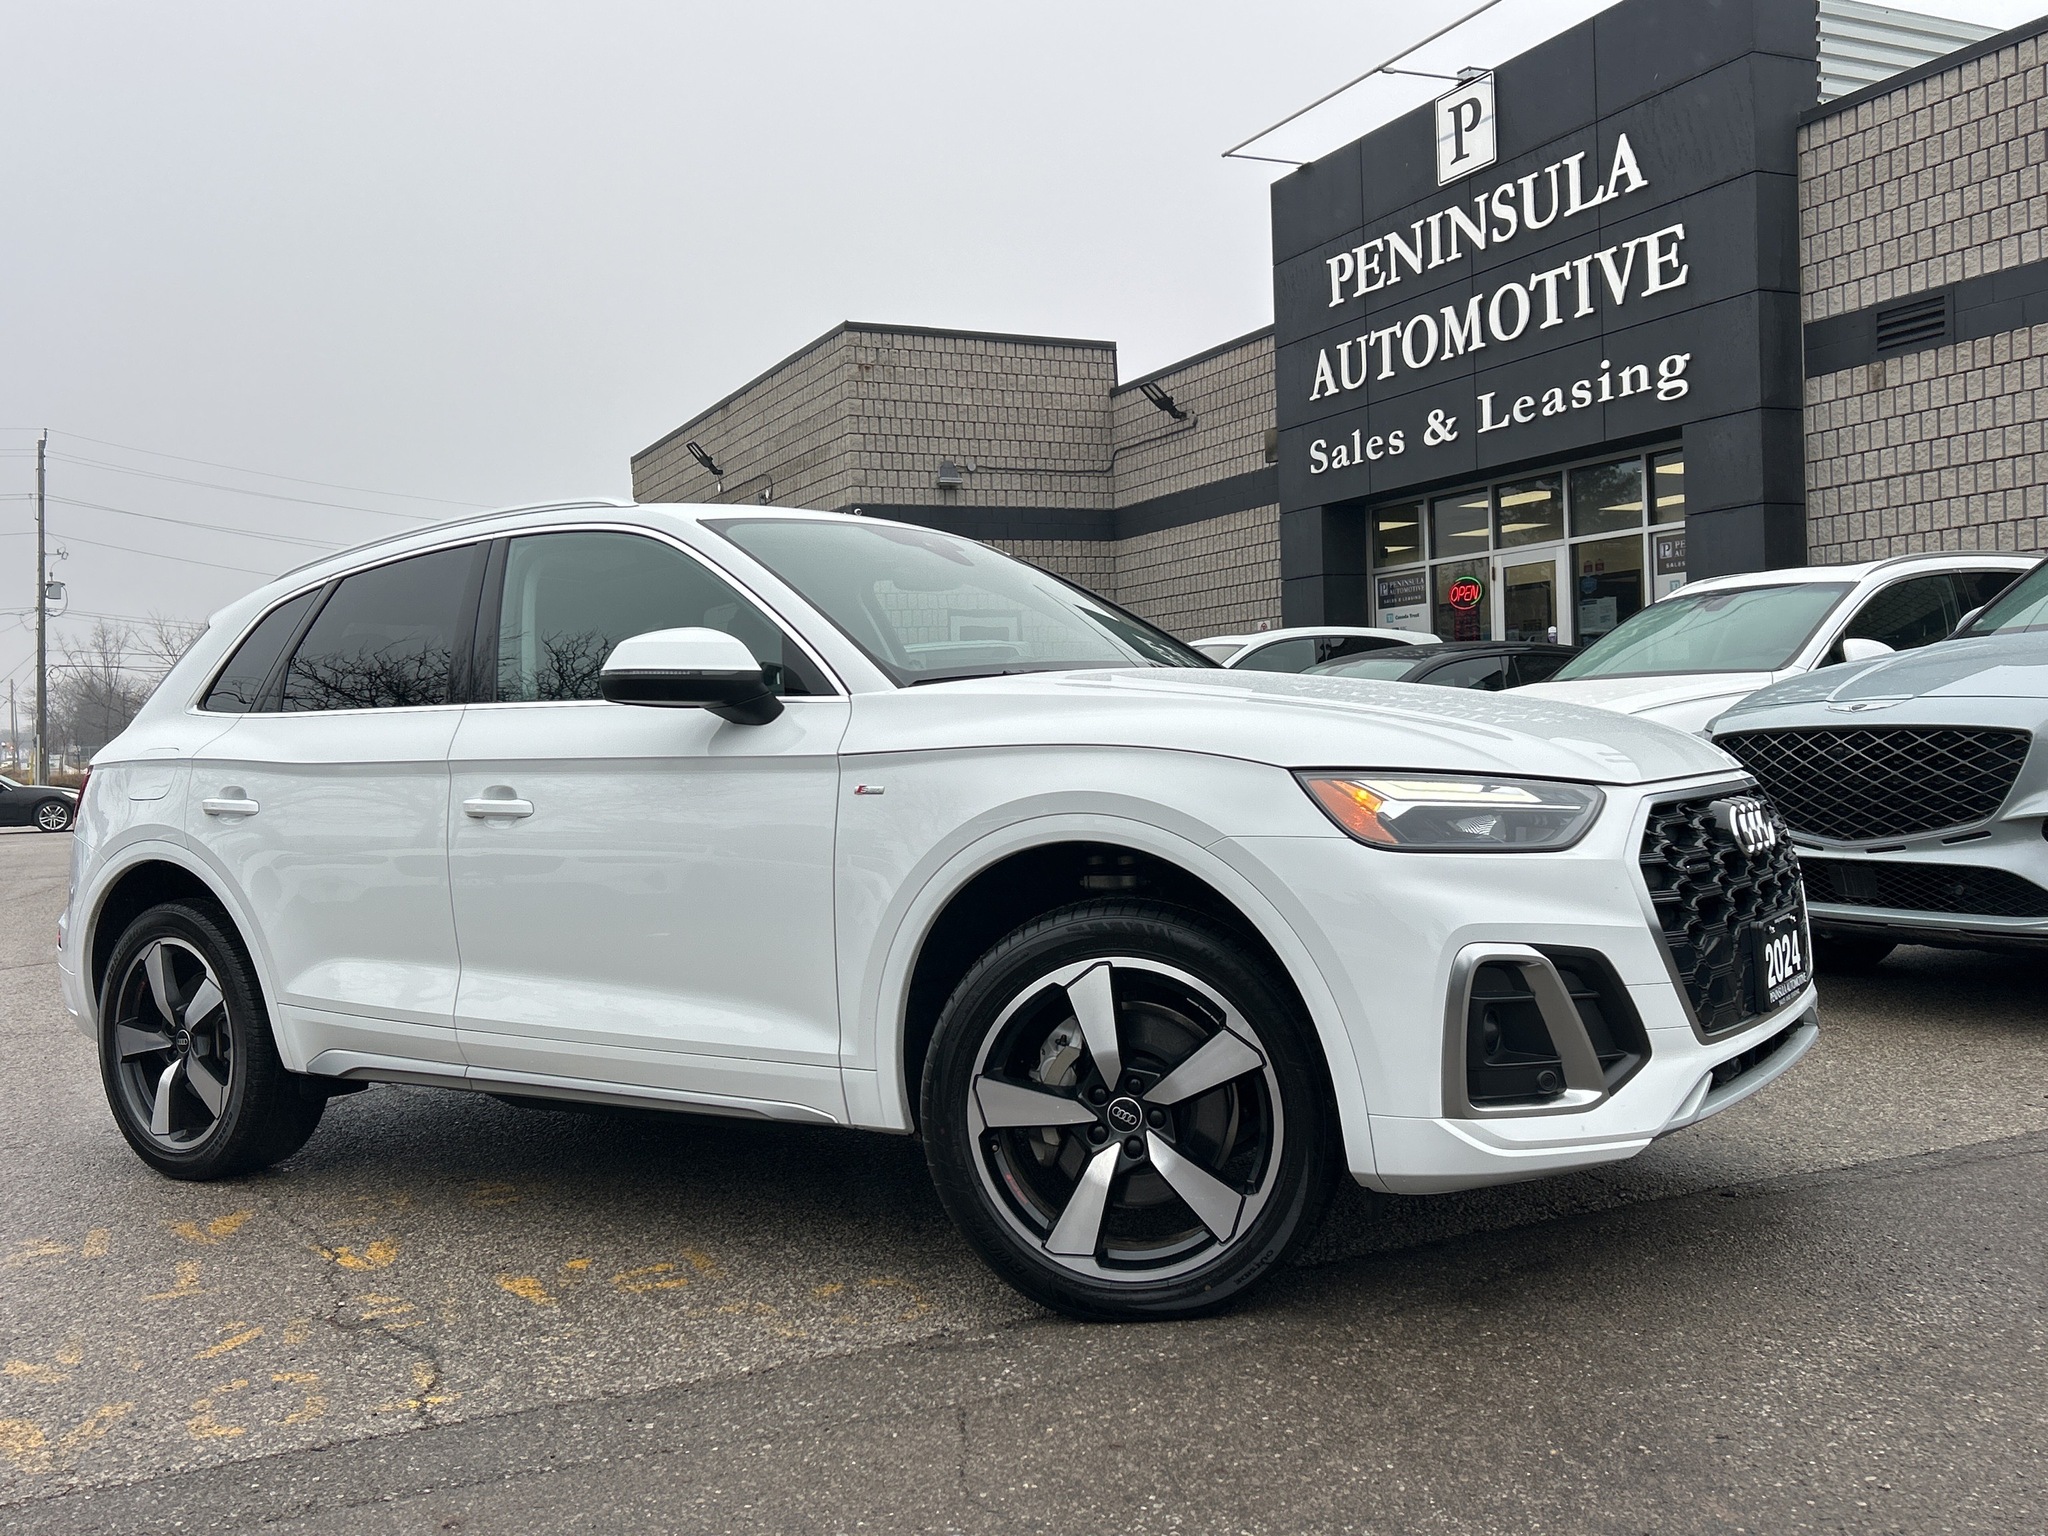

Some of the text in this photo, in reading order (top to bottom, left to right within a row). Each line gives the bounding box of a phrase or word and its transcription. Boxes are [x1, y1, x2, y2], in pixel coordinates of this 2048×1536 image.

[1447, 96, 1482, 166] P
[1326, 132, 1649, 308] PENINSULA
[1308, 223, 1689, 402] AUTOMOTIVE
[1309, 352, 1692, 475] Sales & Leasing
[1450, 585, 1479, 602] OPEN
[1765, 930, 1801, 989] 2024
